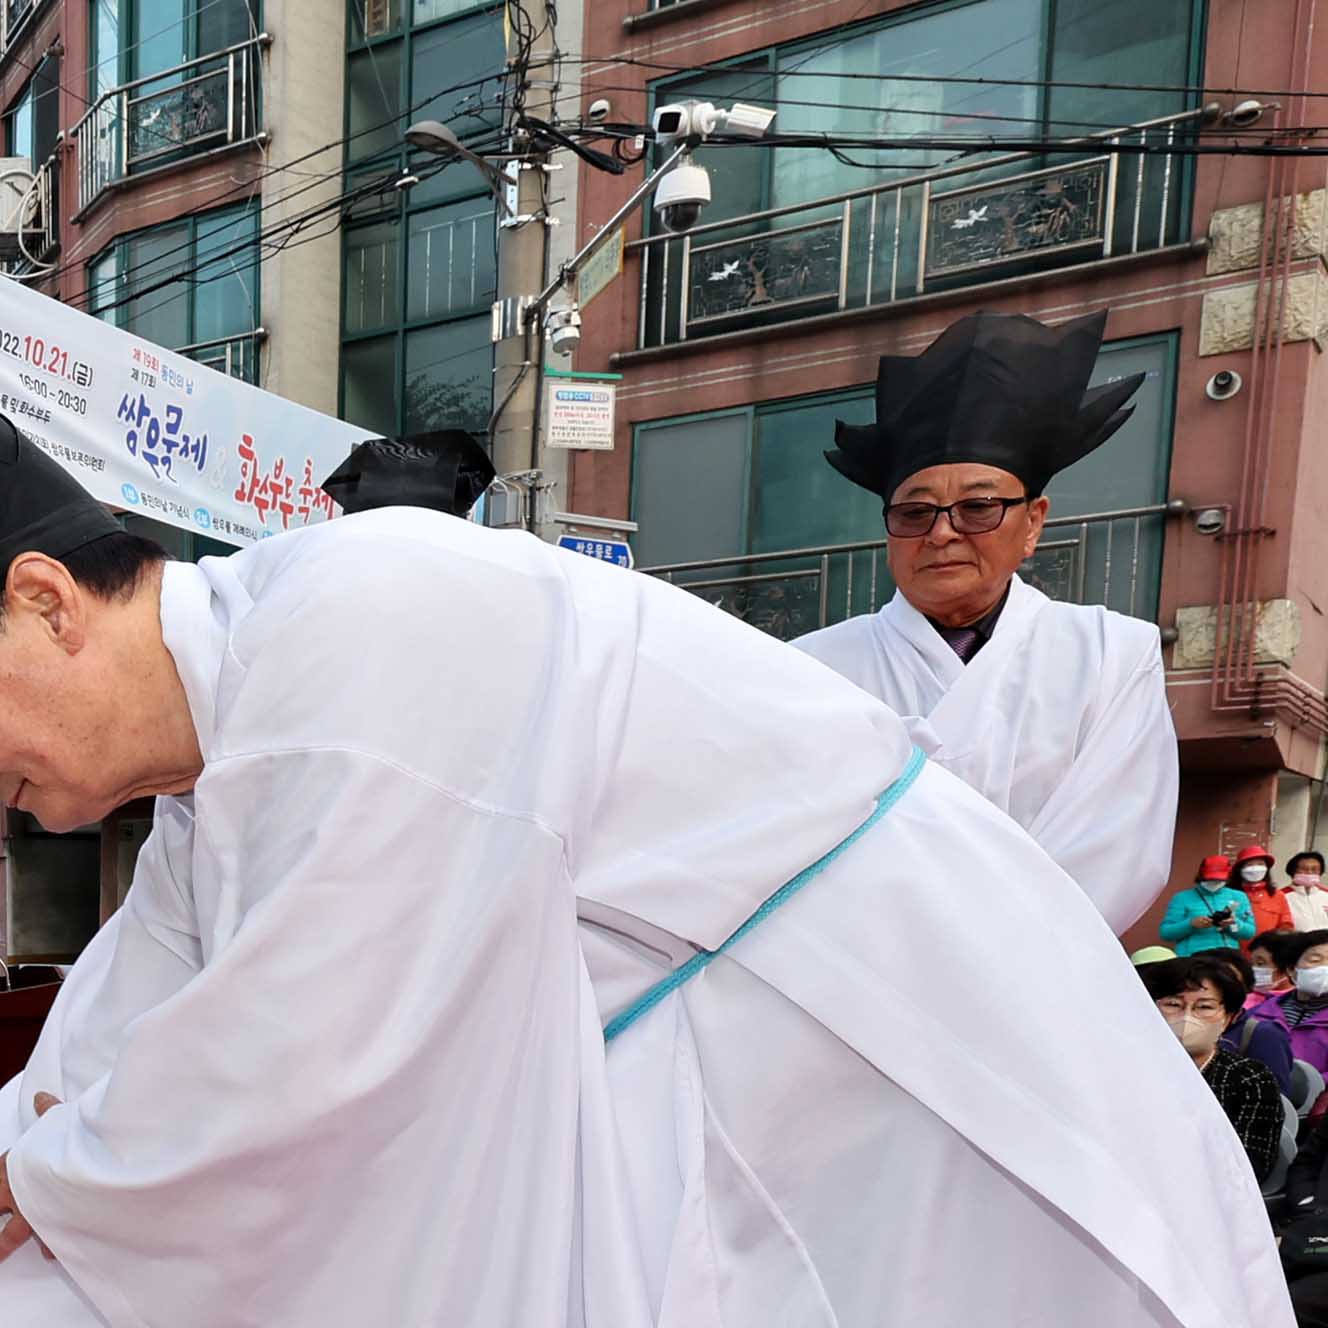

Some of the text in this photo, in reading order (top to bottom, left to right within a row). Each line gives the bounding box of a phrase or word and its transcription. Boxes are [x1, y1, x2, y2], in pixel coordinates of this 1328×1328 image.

[19, 373, 48, 398] 16:00
[58, 390, 87, 415] 20:30
[117, 393, 207, 483] 쌍우물제
